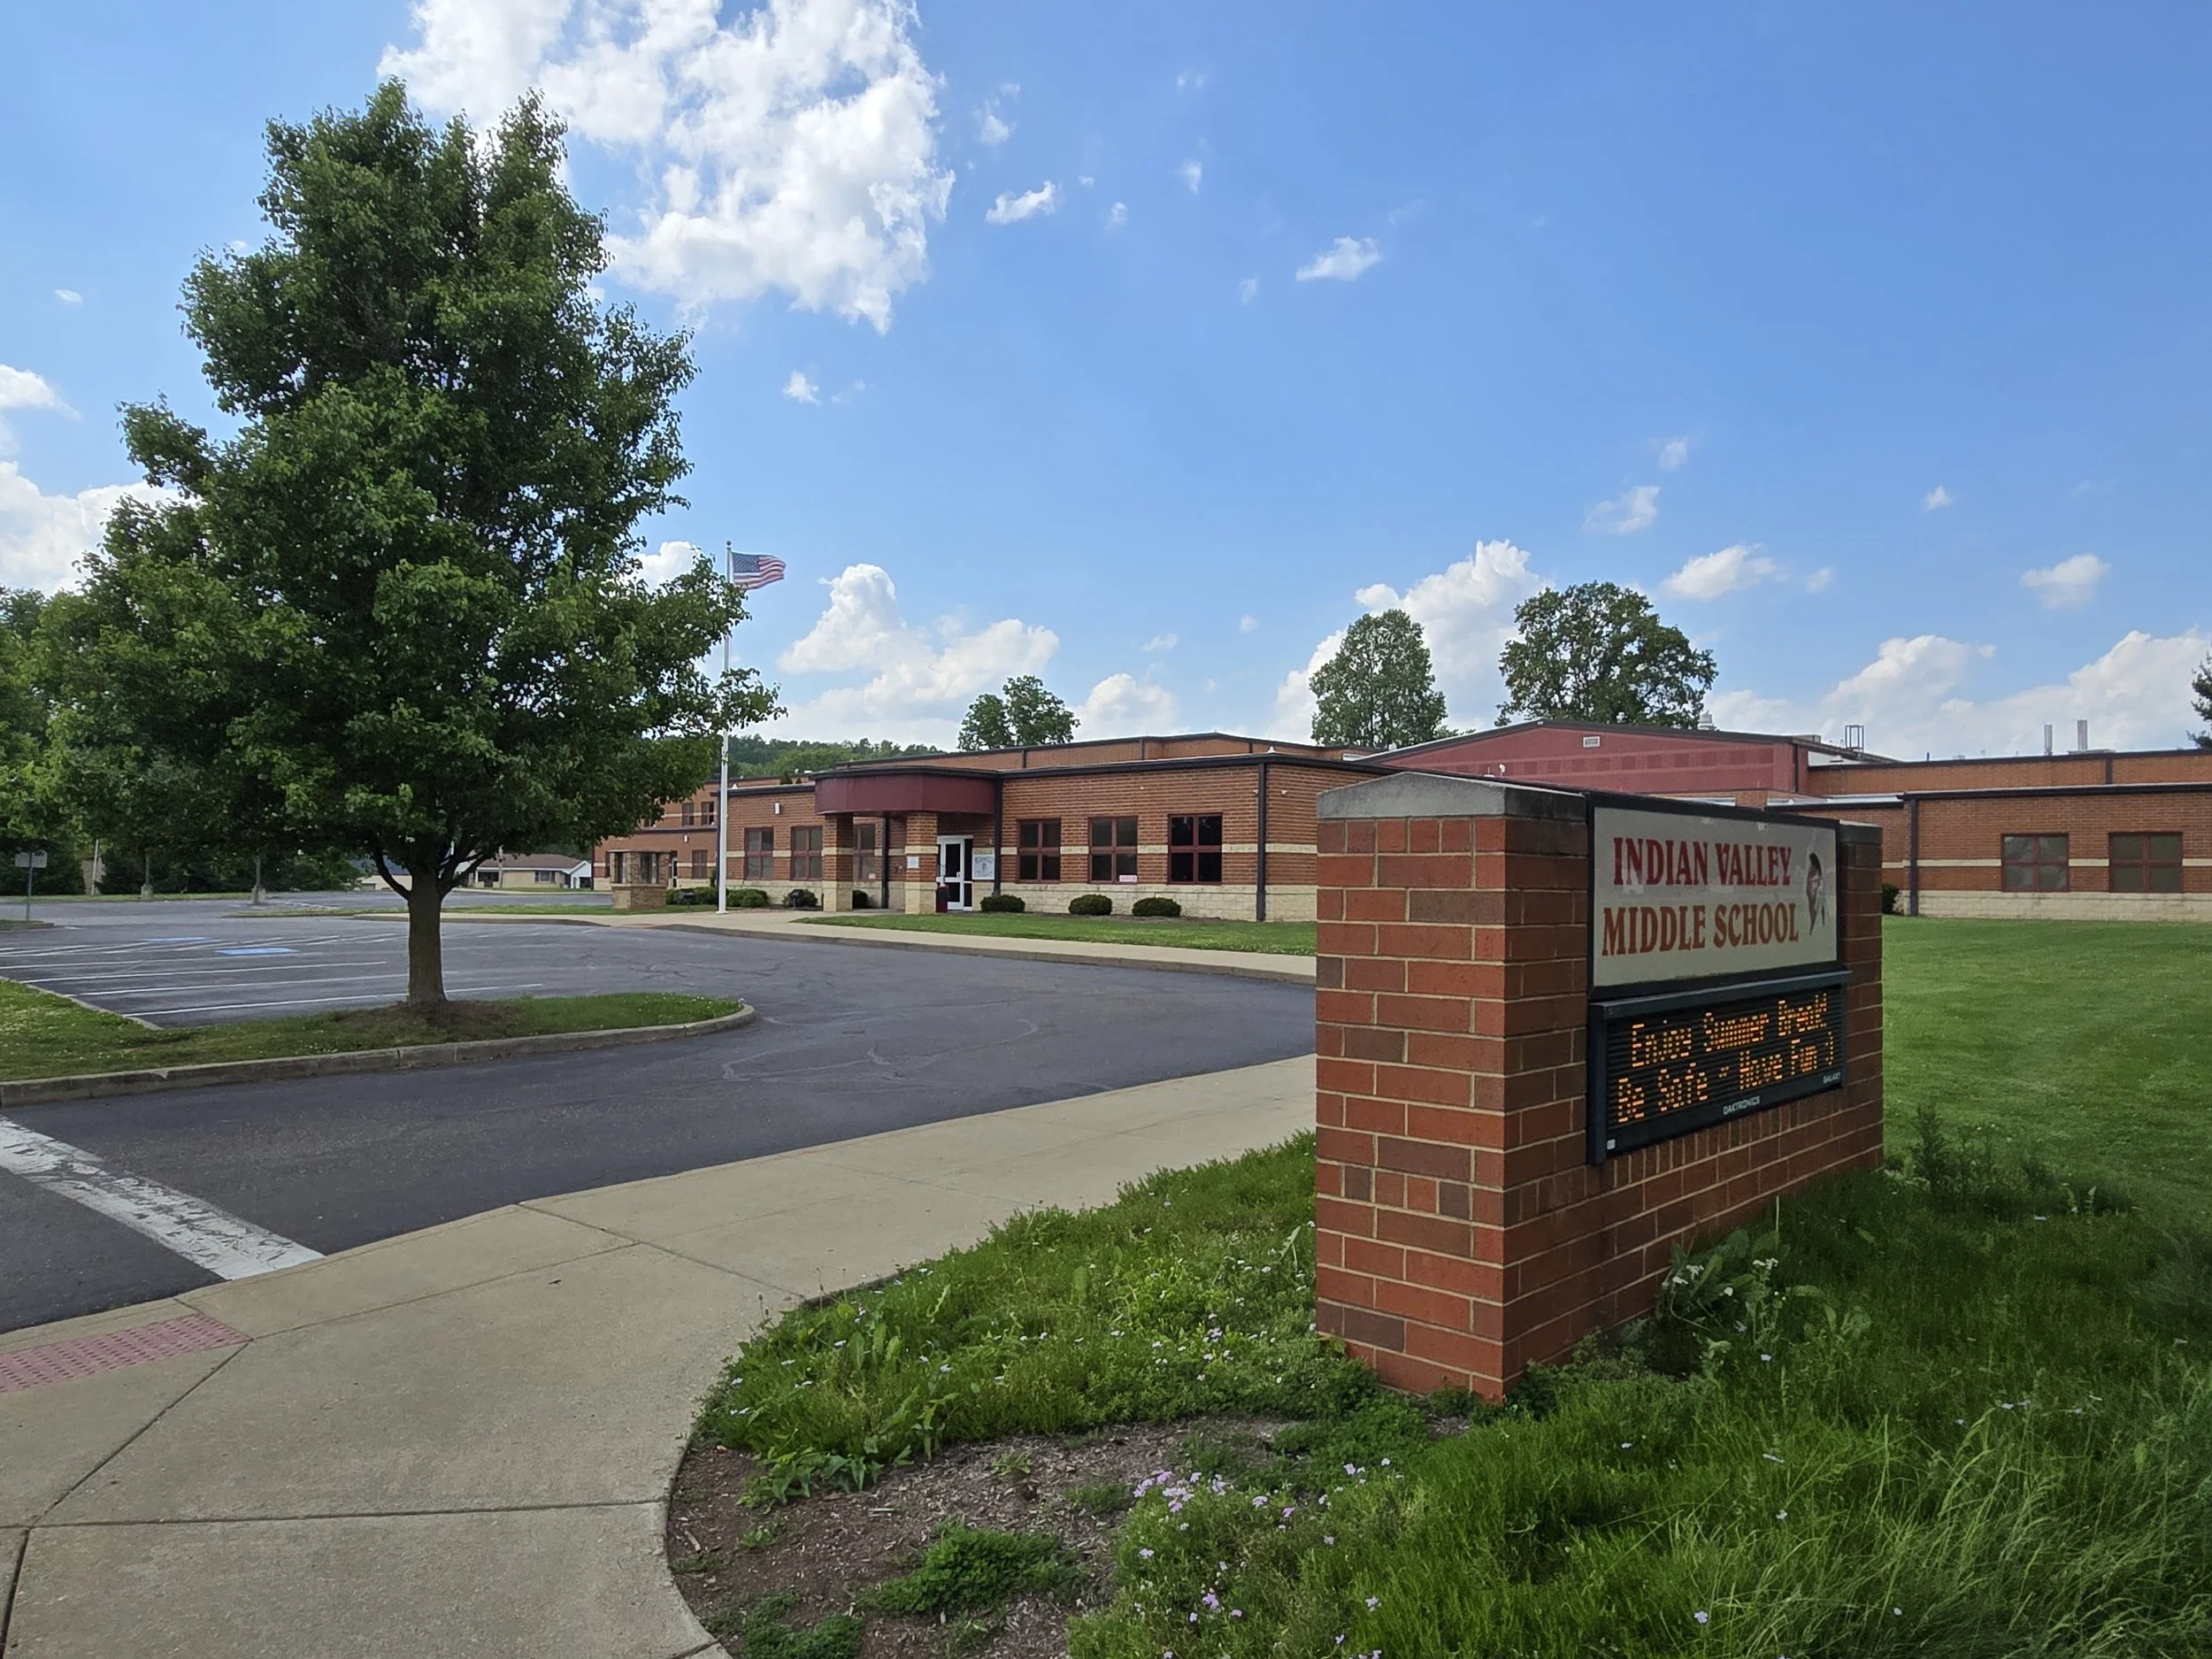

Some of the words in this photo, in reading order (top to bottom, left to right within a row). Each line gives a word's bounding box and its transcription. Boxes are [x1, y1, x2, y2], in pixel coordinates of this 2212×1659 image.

[1613, 837, 1709, 886] INDIAN
[1715, 842, 1792, 887] VALLEY
[1601, 905, 1706, 956] MIDDLE
[1713, 902, 1799, 949] SCHOOL
[1632, 1019, 1692, 1068] Enjoy
[1702, 1012, 1770, 1051] Summer
[1617, 1077, 1645, 1122] Be
[1657, 1062, 1709, 1111] Safe
[1739, 1049, 1784, 1090] Have
[1791, 1038, 1818, 1075] Fun
[1723, 1095, 1761, 1116] DAKTRONICS
